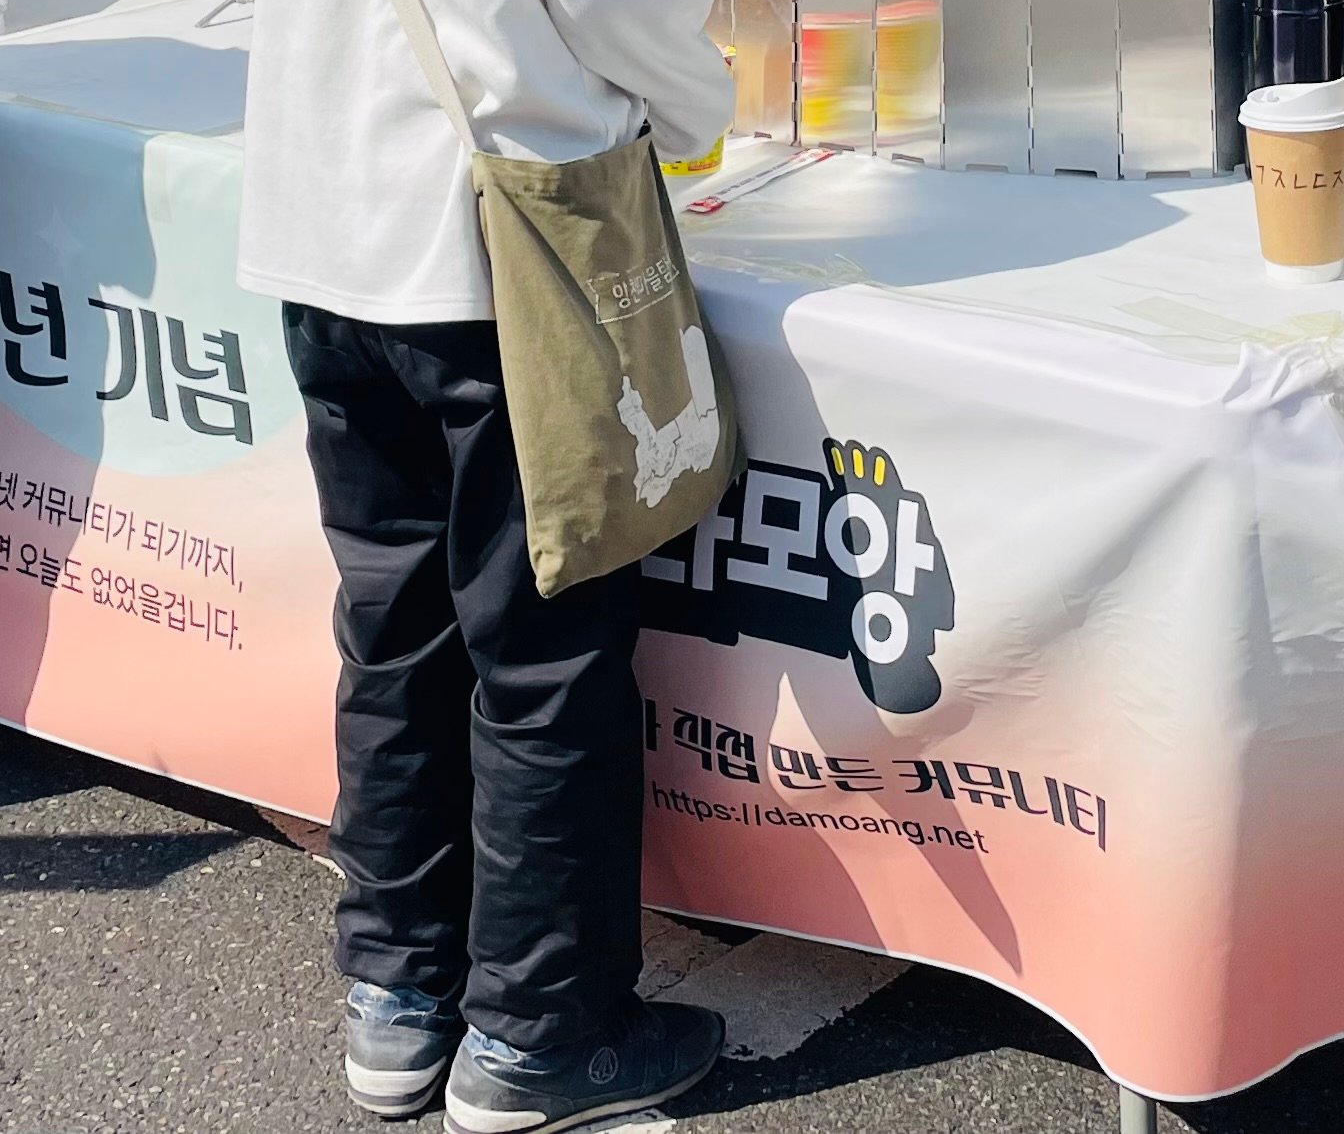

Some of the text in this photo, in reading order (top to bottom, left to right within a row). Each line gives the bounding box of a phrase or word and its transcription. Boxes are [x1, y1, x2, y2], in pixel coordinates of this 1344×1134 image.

[87, 296, 255, 447] 기념
[21, 480, 137, 552] 커뮤니티가
[139, 518, 246, 594] 되기까지,
[16, 541, 84, 596] 오늘도
[90, 566, 246, 653] 없었을겁니다.
[654, 780, 990, 855] https://damoang.net
[672, 707, 761, 784] 직접
[769, 743, 884, 794] 만든
[891, 759, 1108, 854] 커뮤니티
